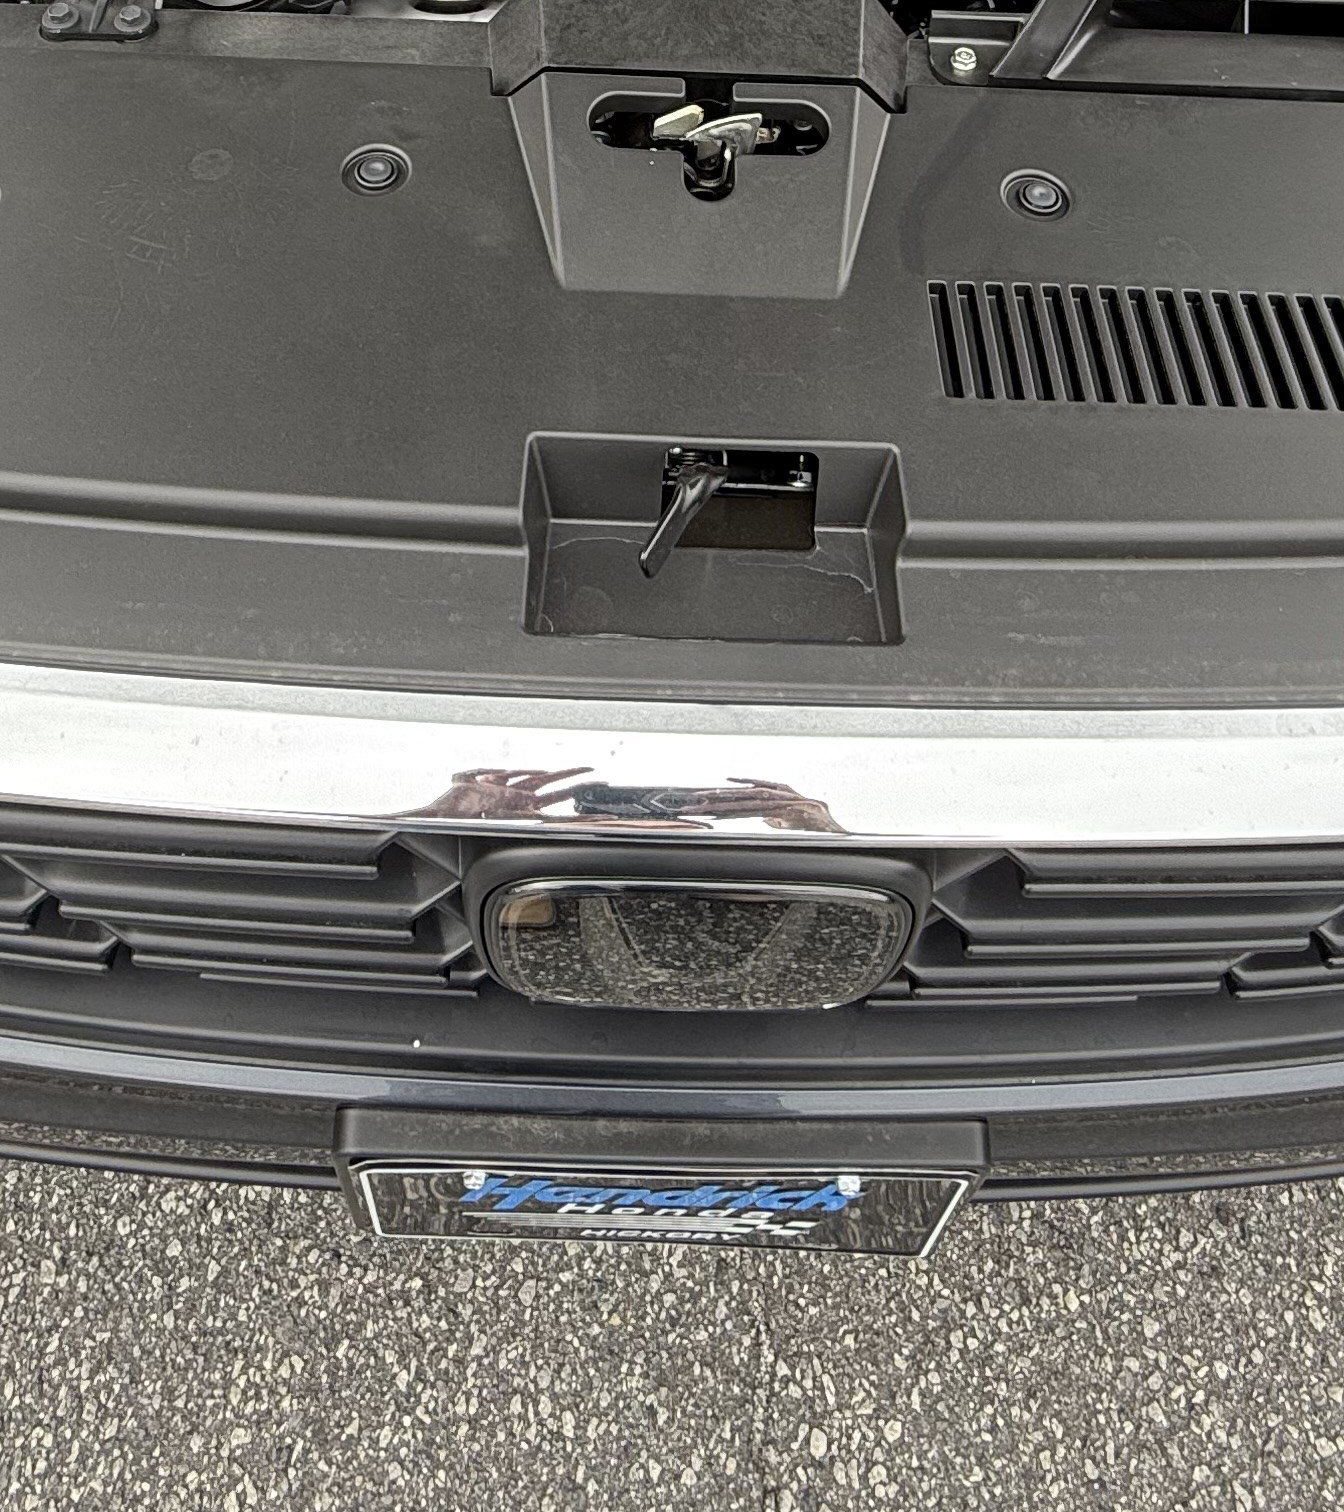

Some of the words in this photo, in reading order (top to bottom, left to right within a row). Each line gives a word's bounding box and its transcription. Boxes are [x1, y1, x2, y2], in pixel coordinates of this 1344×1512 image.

[459, 1176, 865, 1211] Hendrick
[557, 1203, 774, 1219] Honda
[580, 1228, 741, 1240] HICKORY
